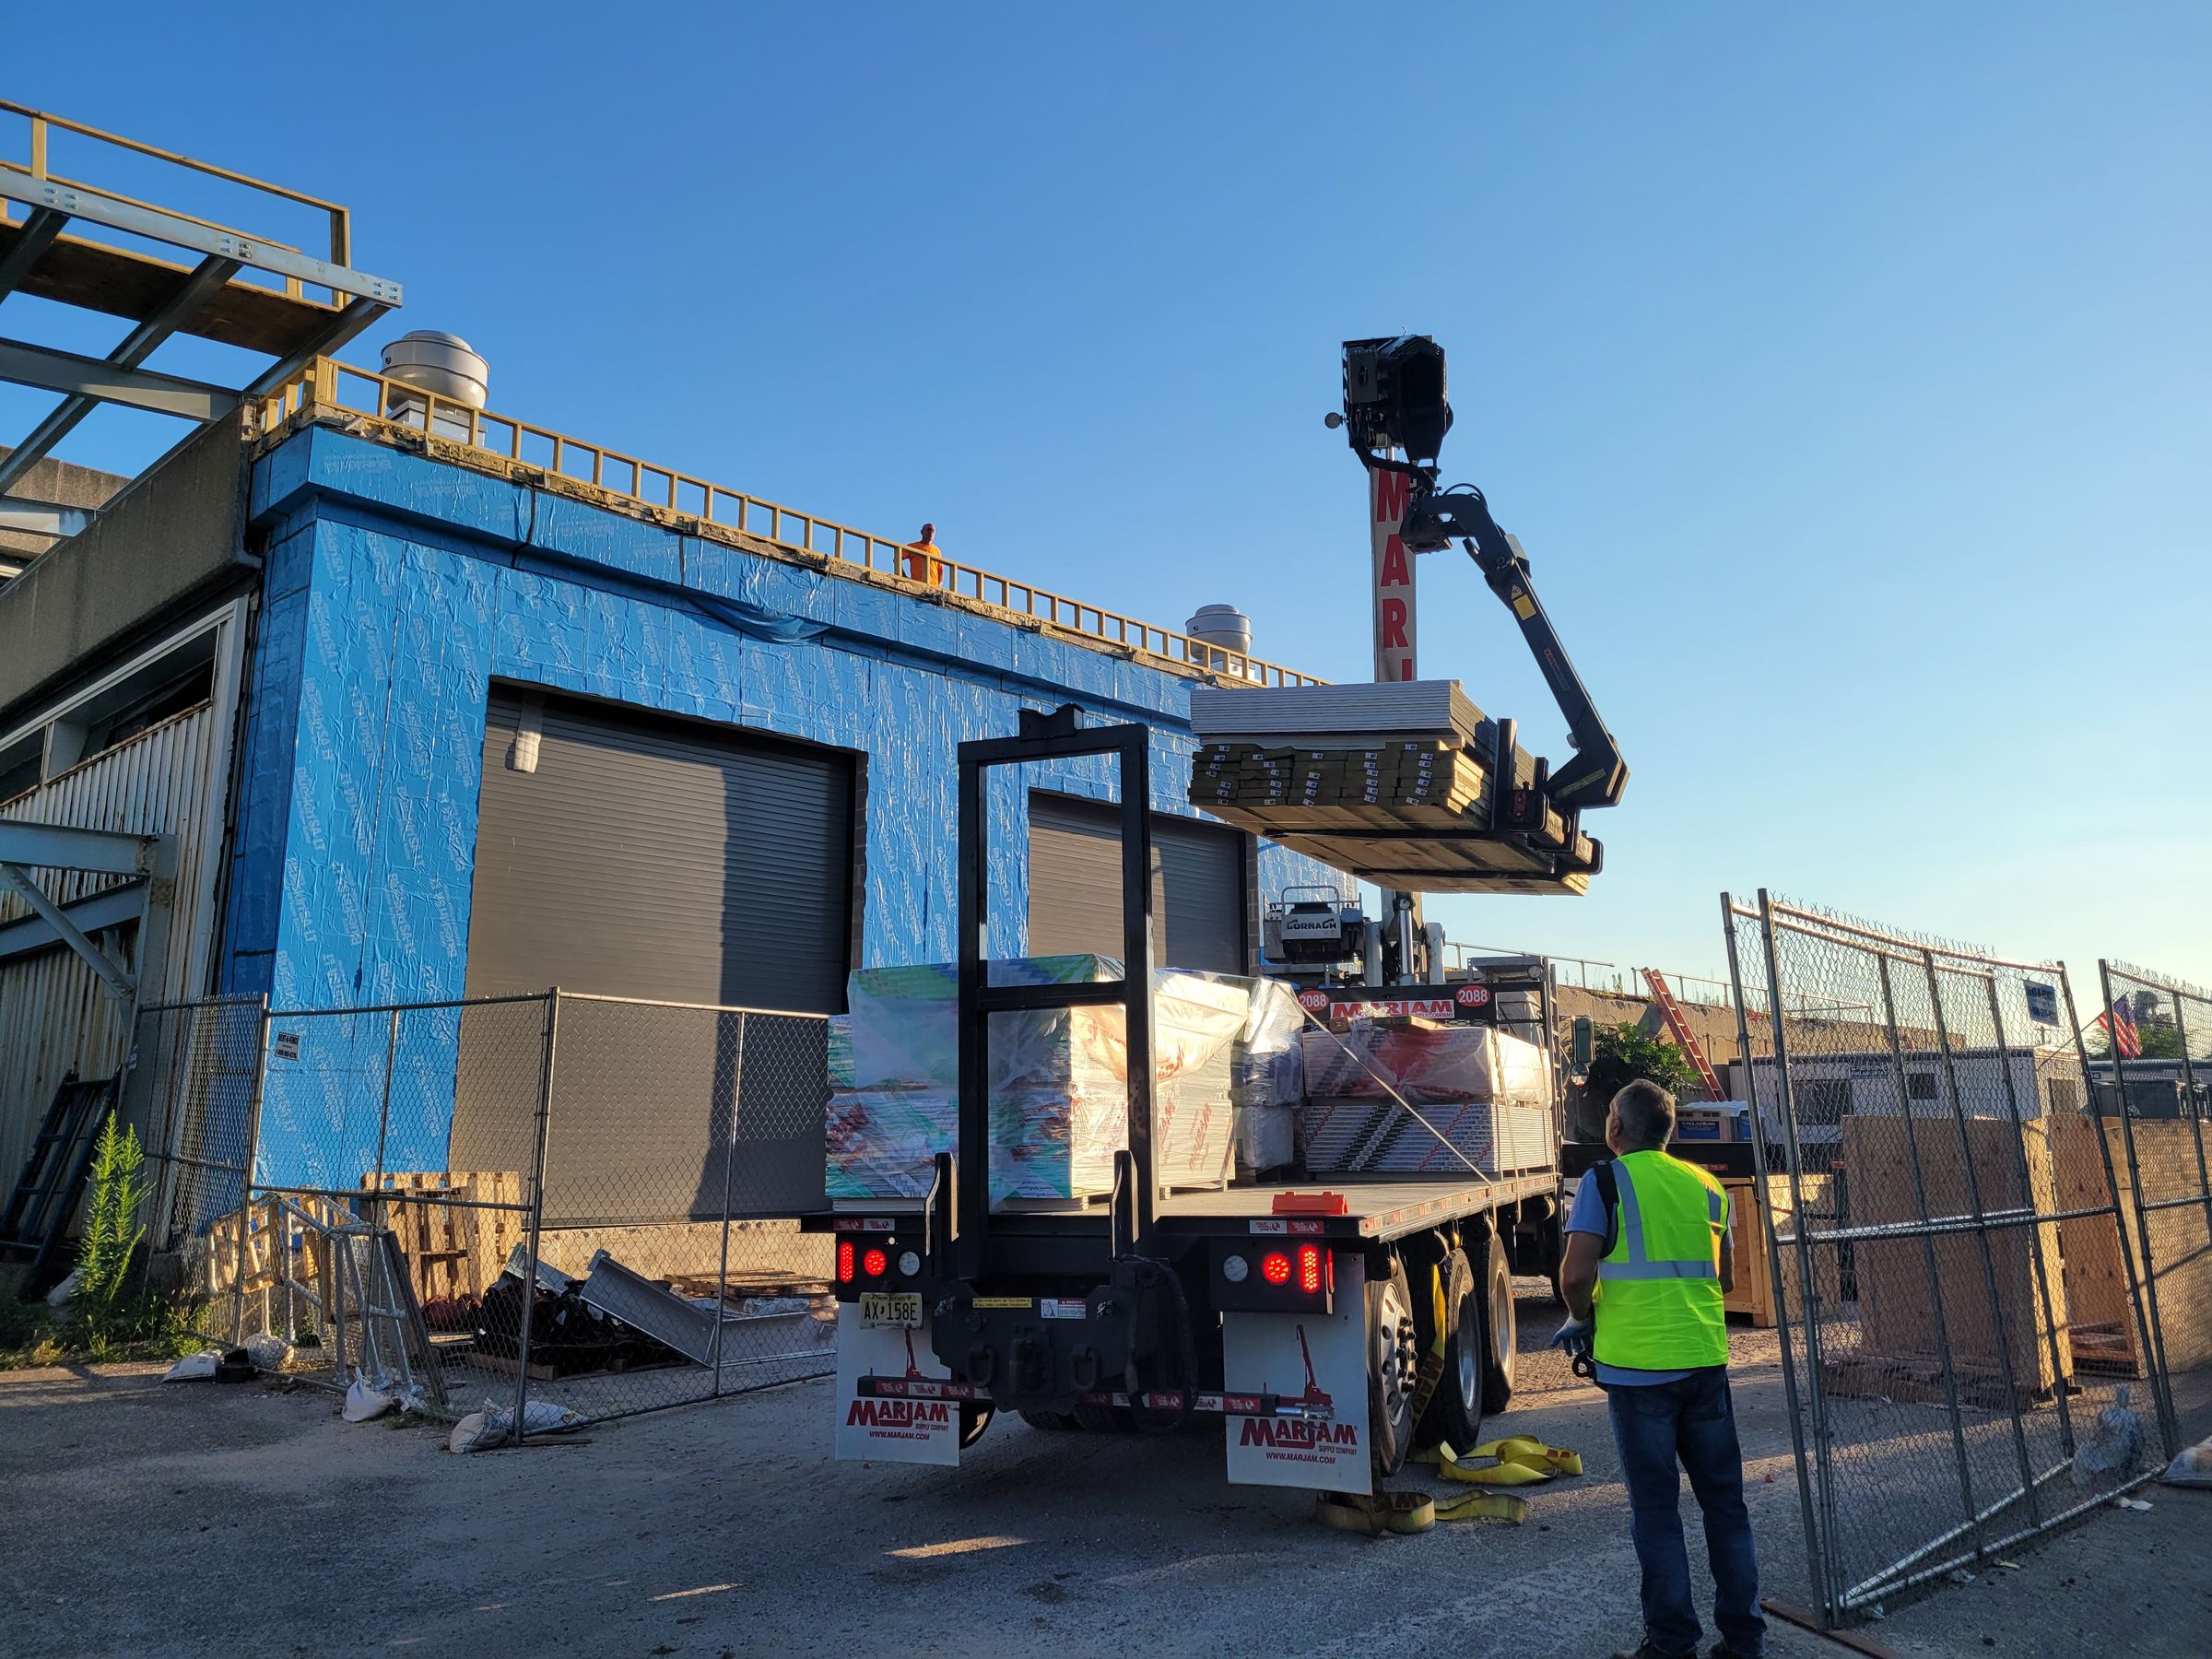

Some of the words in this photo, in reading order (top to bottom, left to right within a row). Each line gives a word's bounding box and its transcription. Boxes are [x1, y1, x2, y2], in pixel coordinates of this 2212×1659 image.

[1287, 918, 1336, 930] CORMACH
[1300, 994, 1327, 1007] 2088
[1458, 990, 1488, 1004] 2088
[864, 1302, 878, 1320] AX
[886, 1302, 918, 1321] 158E
[846, 1400, 950, 1428] MARJAM
[869, 1430, 931, 1441] WWW.MARJAM.COM
[1239, 1418, 1359, 1450] MARJAM
[1318, 1444, 1335, 1453] SUPPLY
[1335, 1446, 1358, 1456] COMPANY
[1265, 1452, 1336, 1465] WWW.MARJAM.COM
